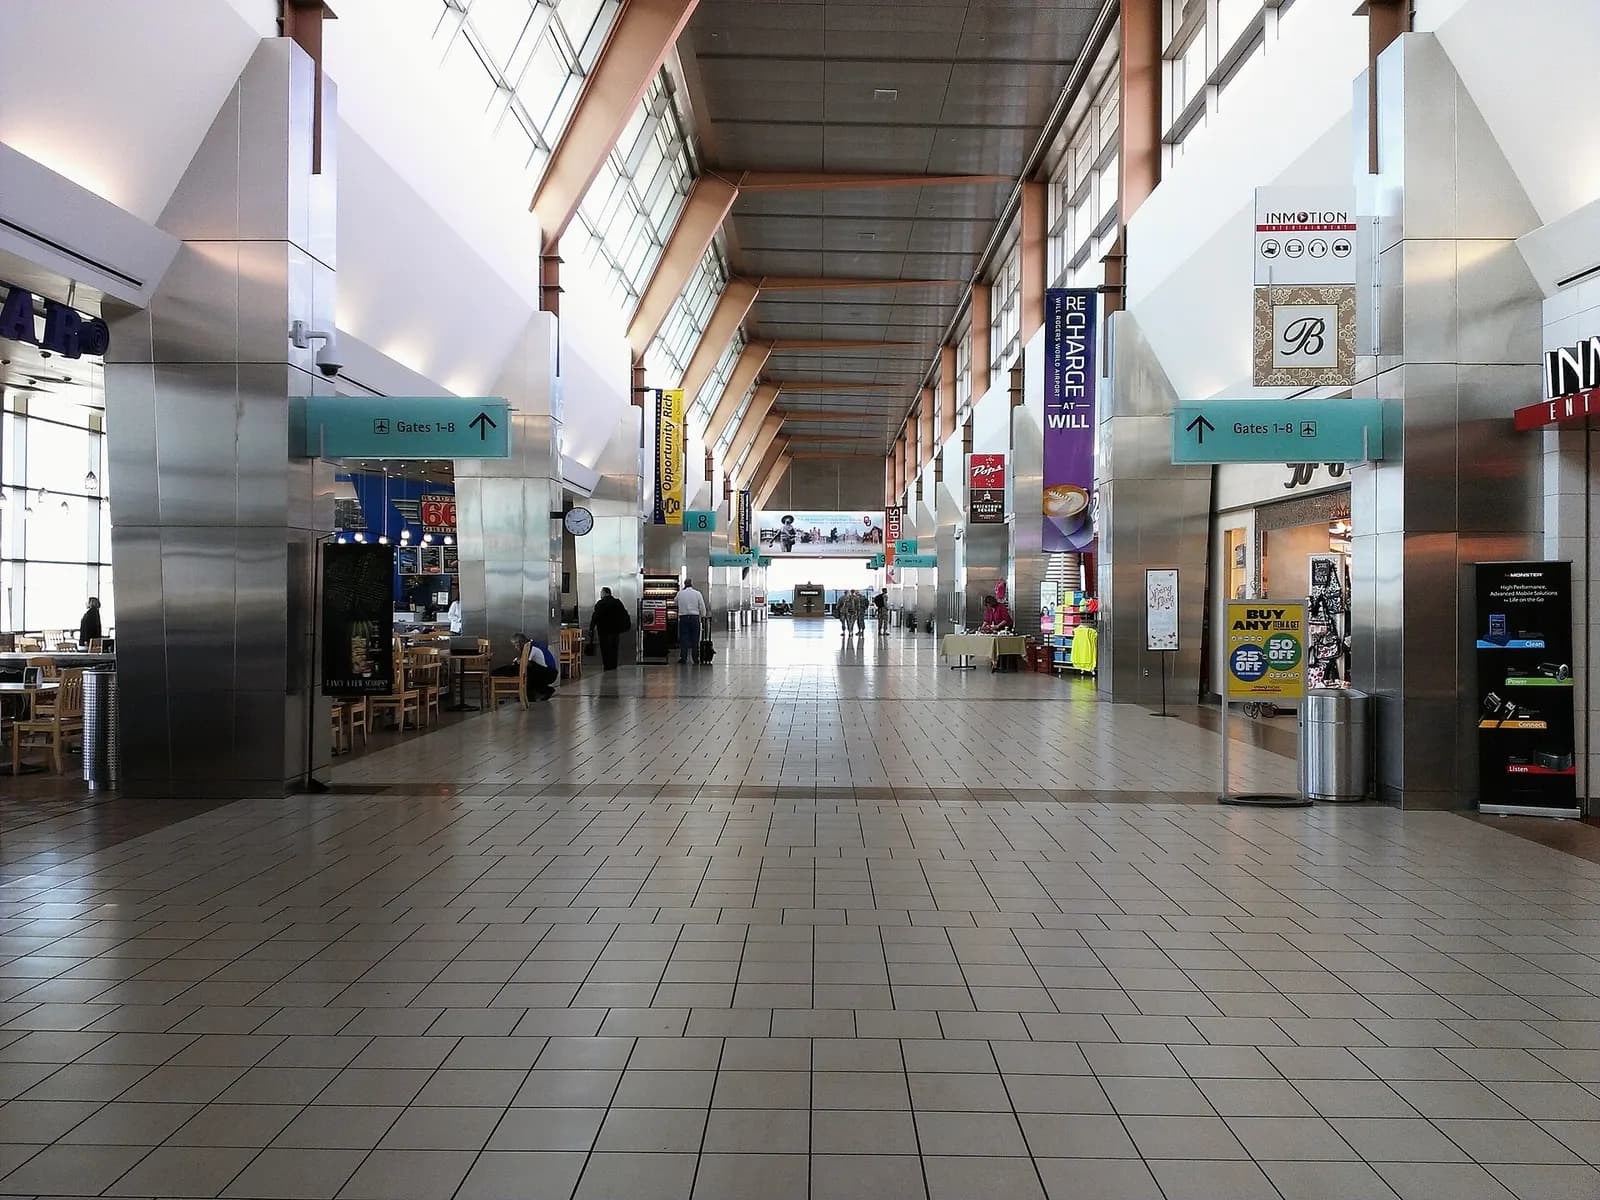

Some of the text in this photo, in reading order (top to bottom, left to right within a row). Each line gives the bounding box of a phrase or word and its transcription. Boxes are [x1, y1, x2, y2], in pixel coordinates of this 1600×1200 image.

[1266, 212, 1347, 224] INMOTION
[1063, 402, 1076, 410] AT
[397, 421, 455, 433] Gates 1-8
[1048, 414, 1090, 429] WILL
[1233, 422, 1293, 434] Gates 1-8
[662, 394, 675, 491] Opportunity Rich
[699, 514, 707, 529] 8
[889, 508, 900, 539] SHOP
[901, 542, 908, 552] 5
[1246, 609, 1286, 620] BUY
[1232, 620, 1272, 631] ANY
[1268, 650, 1296, 660] OFF
[1235, 661, 1263, 671] OFF
[1509, 765, 1529, 773] Listen
